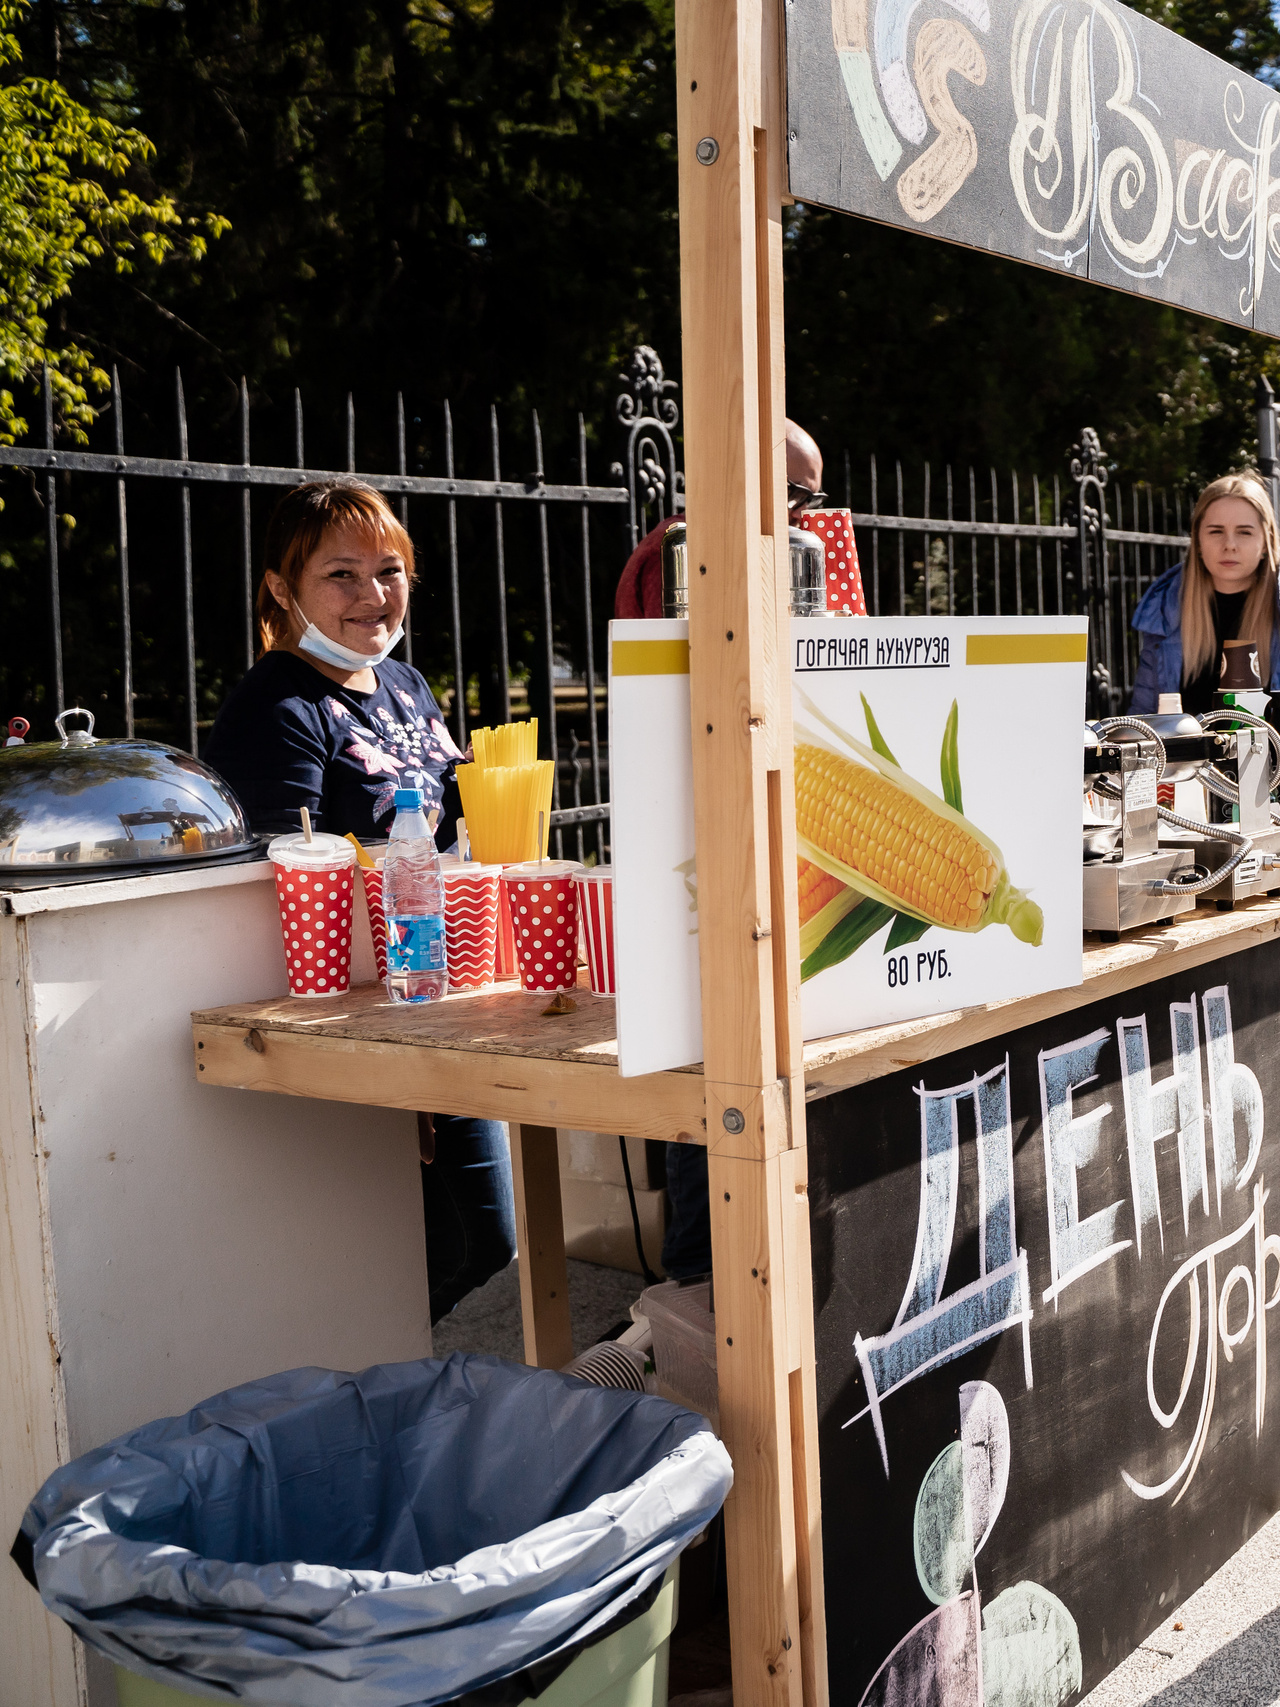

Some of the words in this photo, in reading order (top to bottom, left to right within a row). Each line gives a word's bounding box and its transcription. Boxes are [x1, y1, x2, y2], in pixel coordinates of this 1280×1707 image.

[796, 637, 869, 667] ГОРЯЧАЯ
[876, 636, 950, 665] КУКУРУЗА
[887, 955, 909, 988] 80
[917, 948, 952, 983] РУБ.
[841, 984, 1265, 1481] ДЕНЬ
